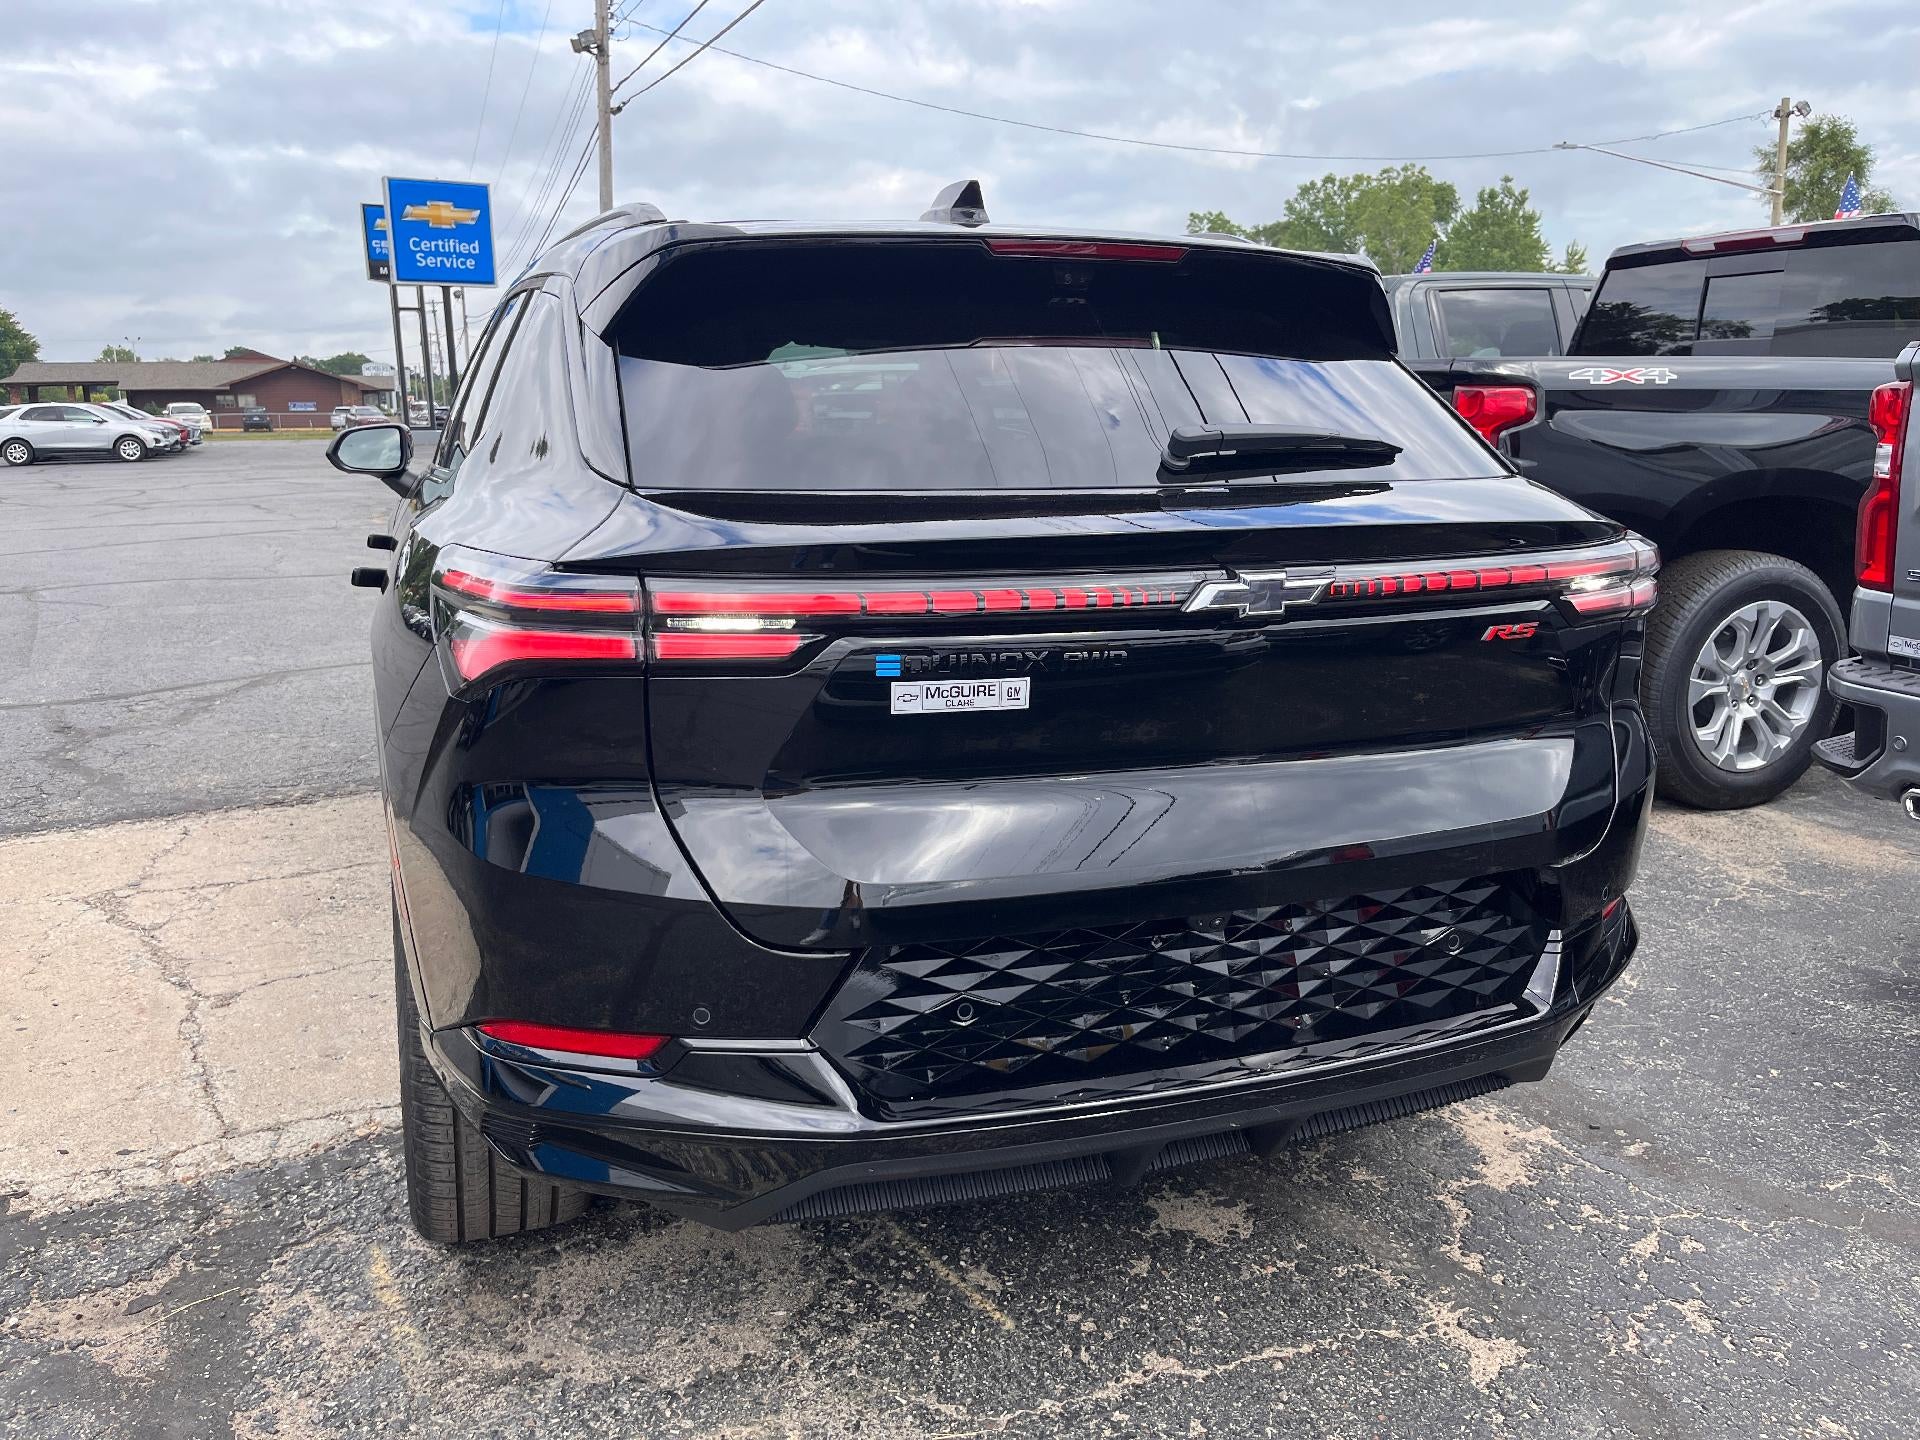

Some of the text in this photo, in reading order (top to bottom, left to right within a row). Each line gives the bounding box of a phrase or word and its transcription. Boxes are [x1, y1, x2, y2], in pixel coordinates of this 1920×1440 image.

[409, 237, 480, 255] Certified
[416, 252, 476, 269] Service
[1480, 621, 1540, 641] RS
[875, 650, 1049, 677] EQUINOX
[925, 684, 997, 699] McGUIRE
